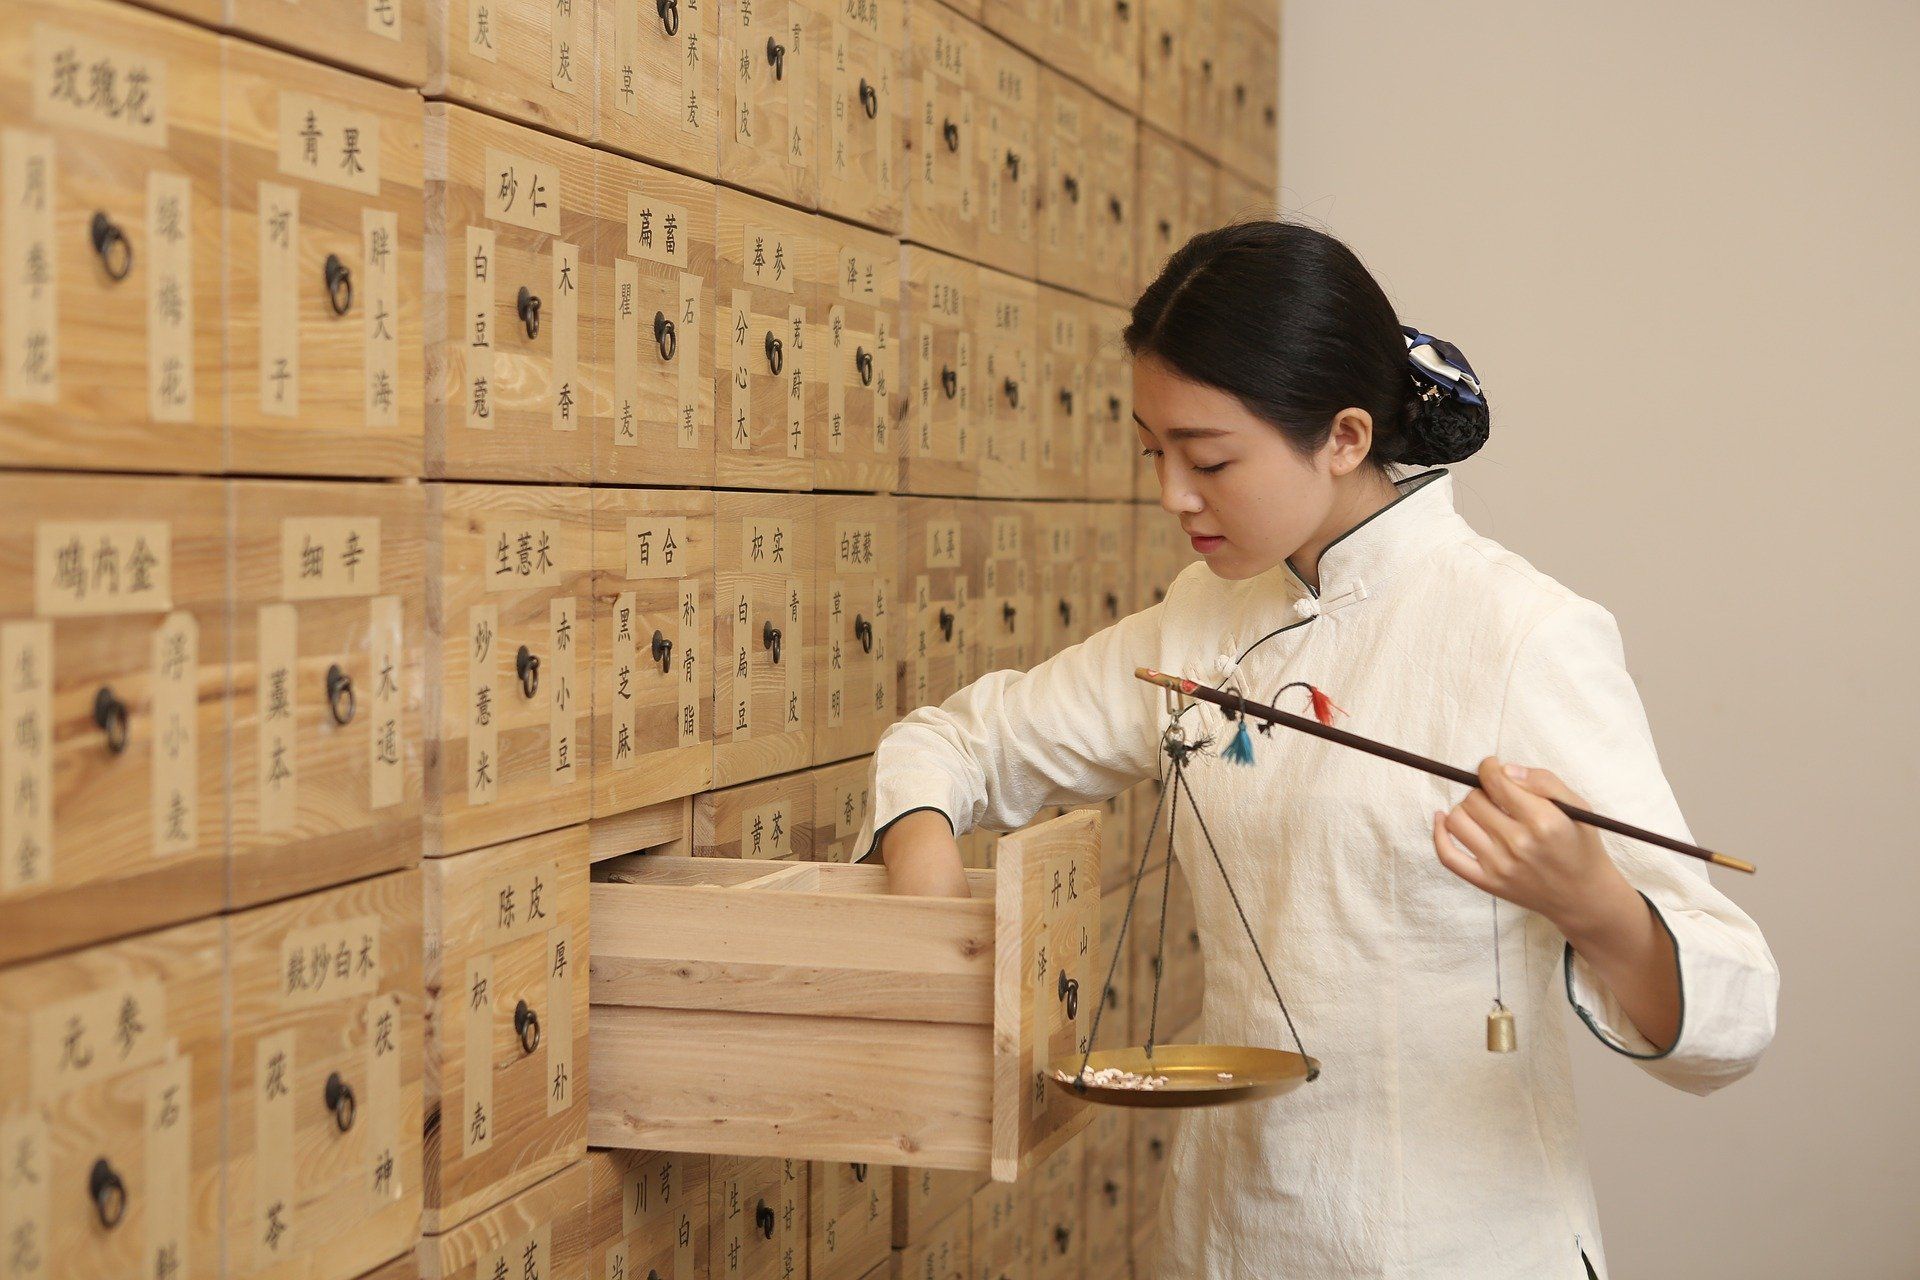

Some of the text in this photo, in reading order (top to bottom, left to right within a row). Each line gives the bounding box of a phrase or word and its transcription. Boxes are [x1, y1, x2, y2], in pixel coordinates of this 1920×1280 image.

[473, 5, 493, 50] 炭
[620, 65, 635, 105] 草
[738, 0, 752, 138] 苦楝皮
[298, 108, 365, 176] 青果
[497, 166, 548, 217] 砂仁
[369, 226, 393, 415] 胖大海
[472, 244, 490, 419] 白豆蔻
[557, 257, 575, 420] 木香
[618, 283, 634, 438] 瞿麦
[735, 309, 749, 445] 分心木
[791, 317, 804, 450] 茺蔚子
[832, 316, 843, 447] 紫草
[300, 530, 366, 584] 细辛
[495, 529, 553, 577] 生薏米
[637, 527, 678, 567] 百合
[750, 526, 785, 564] 枳实
[839, 530, 874, 566] 白蒺藜
[375, 655, 399, 766] 木通
[474, 620, 493, 790] 炒薏米
[555, 611, 572, 773] 赤小豆
[615, 607, 632, 761] 黑芝麻
[681, 592, 696, 738] 补骨脂
[735, 594, 748, 732] 白扁豆
[787, 590, 801, 725] 青皮
[750, 810, 784, 856] 黄芩
[1051, 859, 1078, 910] 丹皮
[499, 877, 545, 929] 陈皮
[470, 972, 487, 1146] 枳壳
[551, 940, 568, 1102] 厚朴
[634, 1161, 672, 1215] 川芎
[678, 1213, 691, 1248] 白
